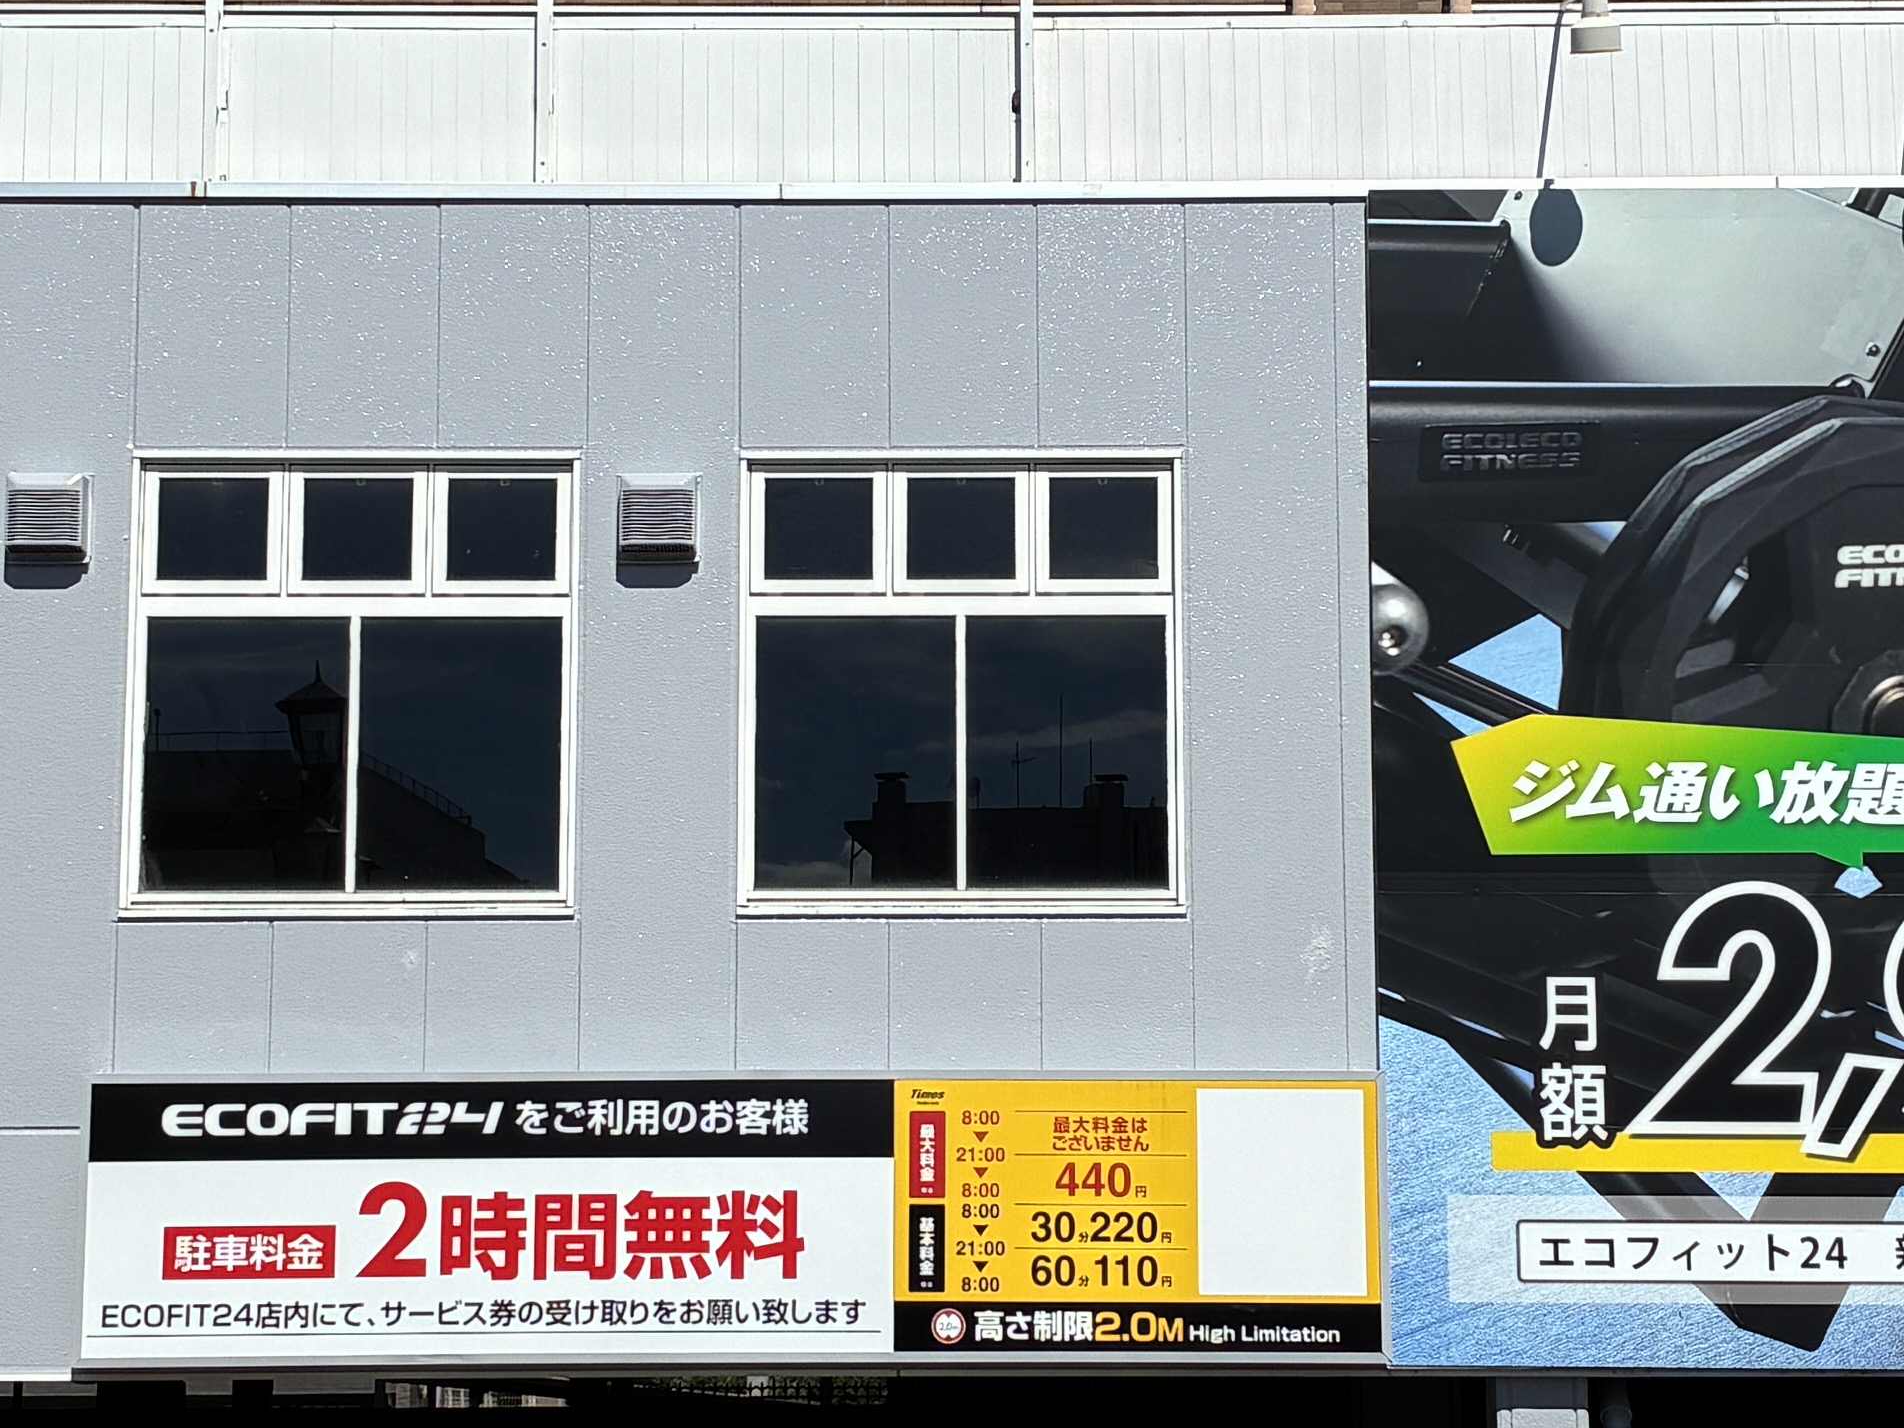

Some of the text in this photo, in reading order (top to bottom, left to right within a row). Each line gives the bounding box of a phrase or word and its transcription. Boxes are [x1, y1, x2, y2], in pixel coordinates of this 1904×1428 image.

[1440, 452, 1581, 472] FITNESS
[1539, 976, 1609, 1142] 月額
[910, 1088, 945, 1100] Times
[961, 1110, 1000, 1125] 8:00
[1053, 1116, 1148, 1134] 最大料金は
[1052, 1135, 1149, 1152] ございません
[956, 1147, 1005, 1162] 21:00
[1055, 1163, 1147, 1198] 440円
[961, 1183, 1000, 1198] 8:00
[961, 1203, 1000, 1218] 8:00
[173, 1181, 806, 1281] 駐車料金 2時間無料
[956, 1241, 1005, 1256] 21:00
[1540, 1236, 1848, 1270] エコフィット24
[961, 1277, 1000, 1292] 8:00
[100, 1298, 868, 1329] ECOFIT24店内にて、サービス券の受け取りをお願い致します
[1188, 1325, 1237, 1344] High
[1241, 1324, 1341, 1344] Limitation
